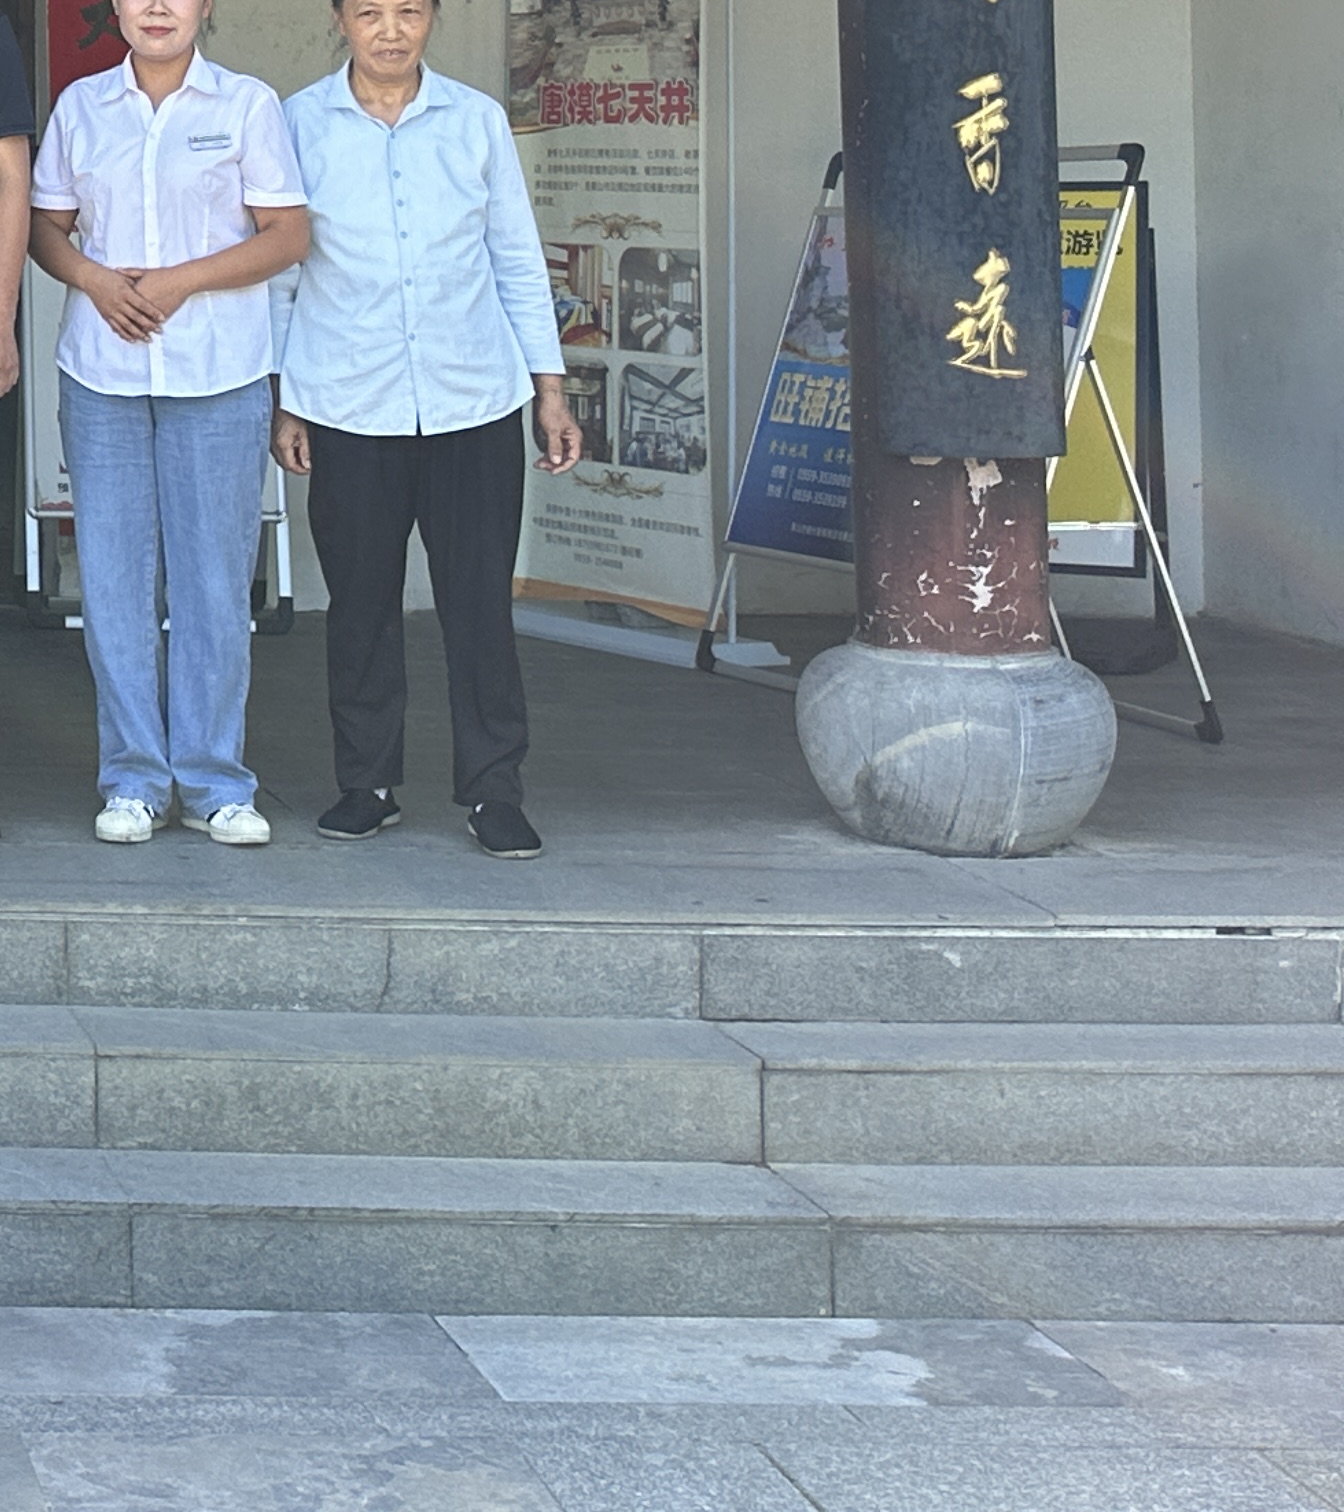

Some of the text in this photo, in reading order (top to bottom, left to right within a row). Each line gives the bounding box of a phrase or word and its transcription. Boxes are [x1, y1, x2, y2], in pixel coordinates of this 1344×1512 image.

[539, 78, 691, 127] 唐模七天井
